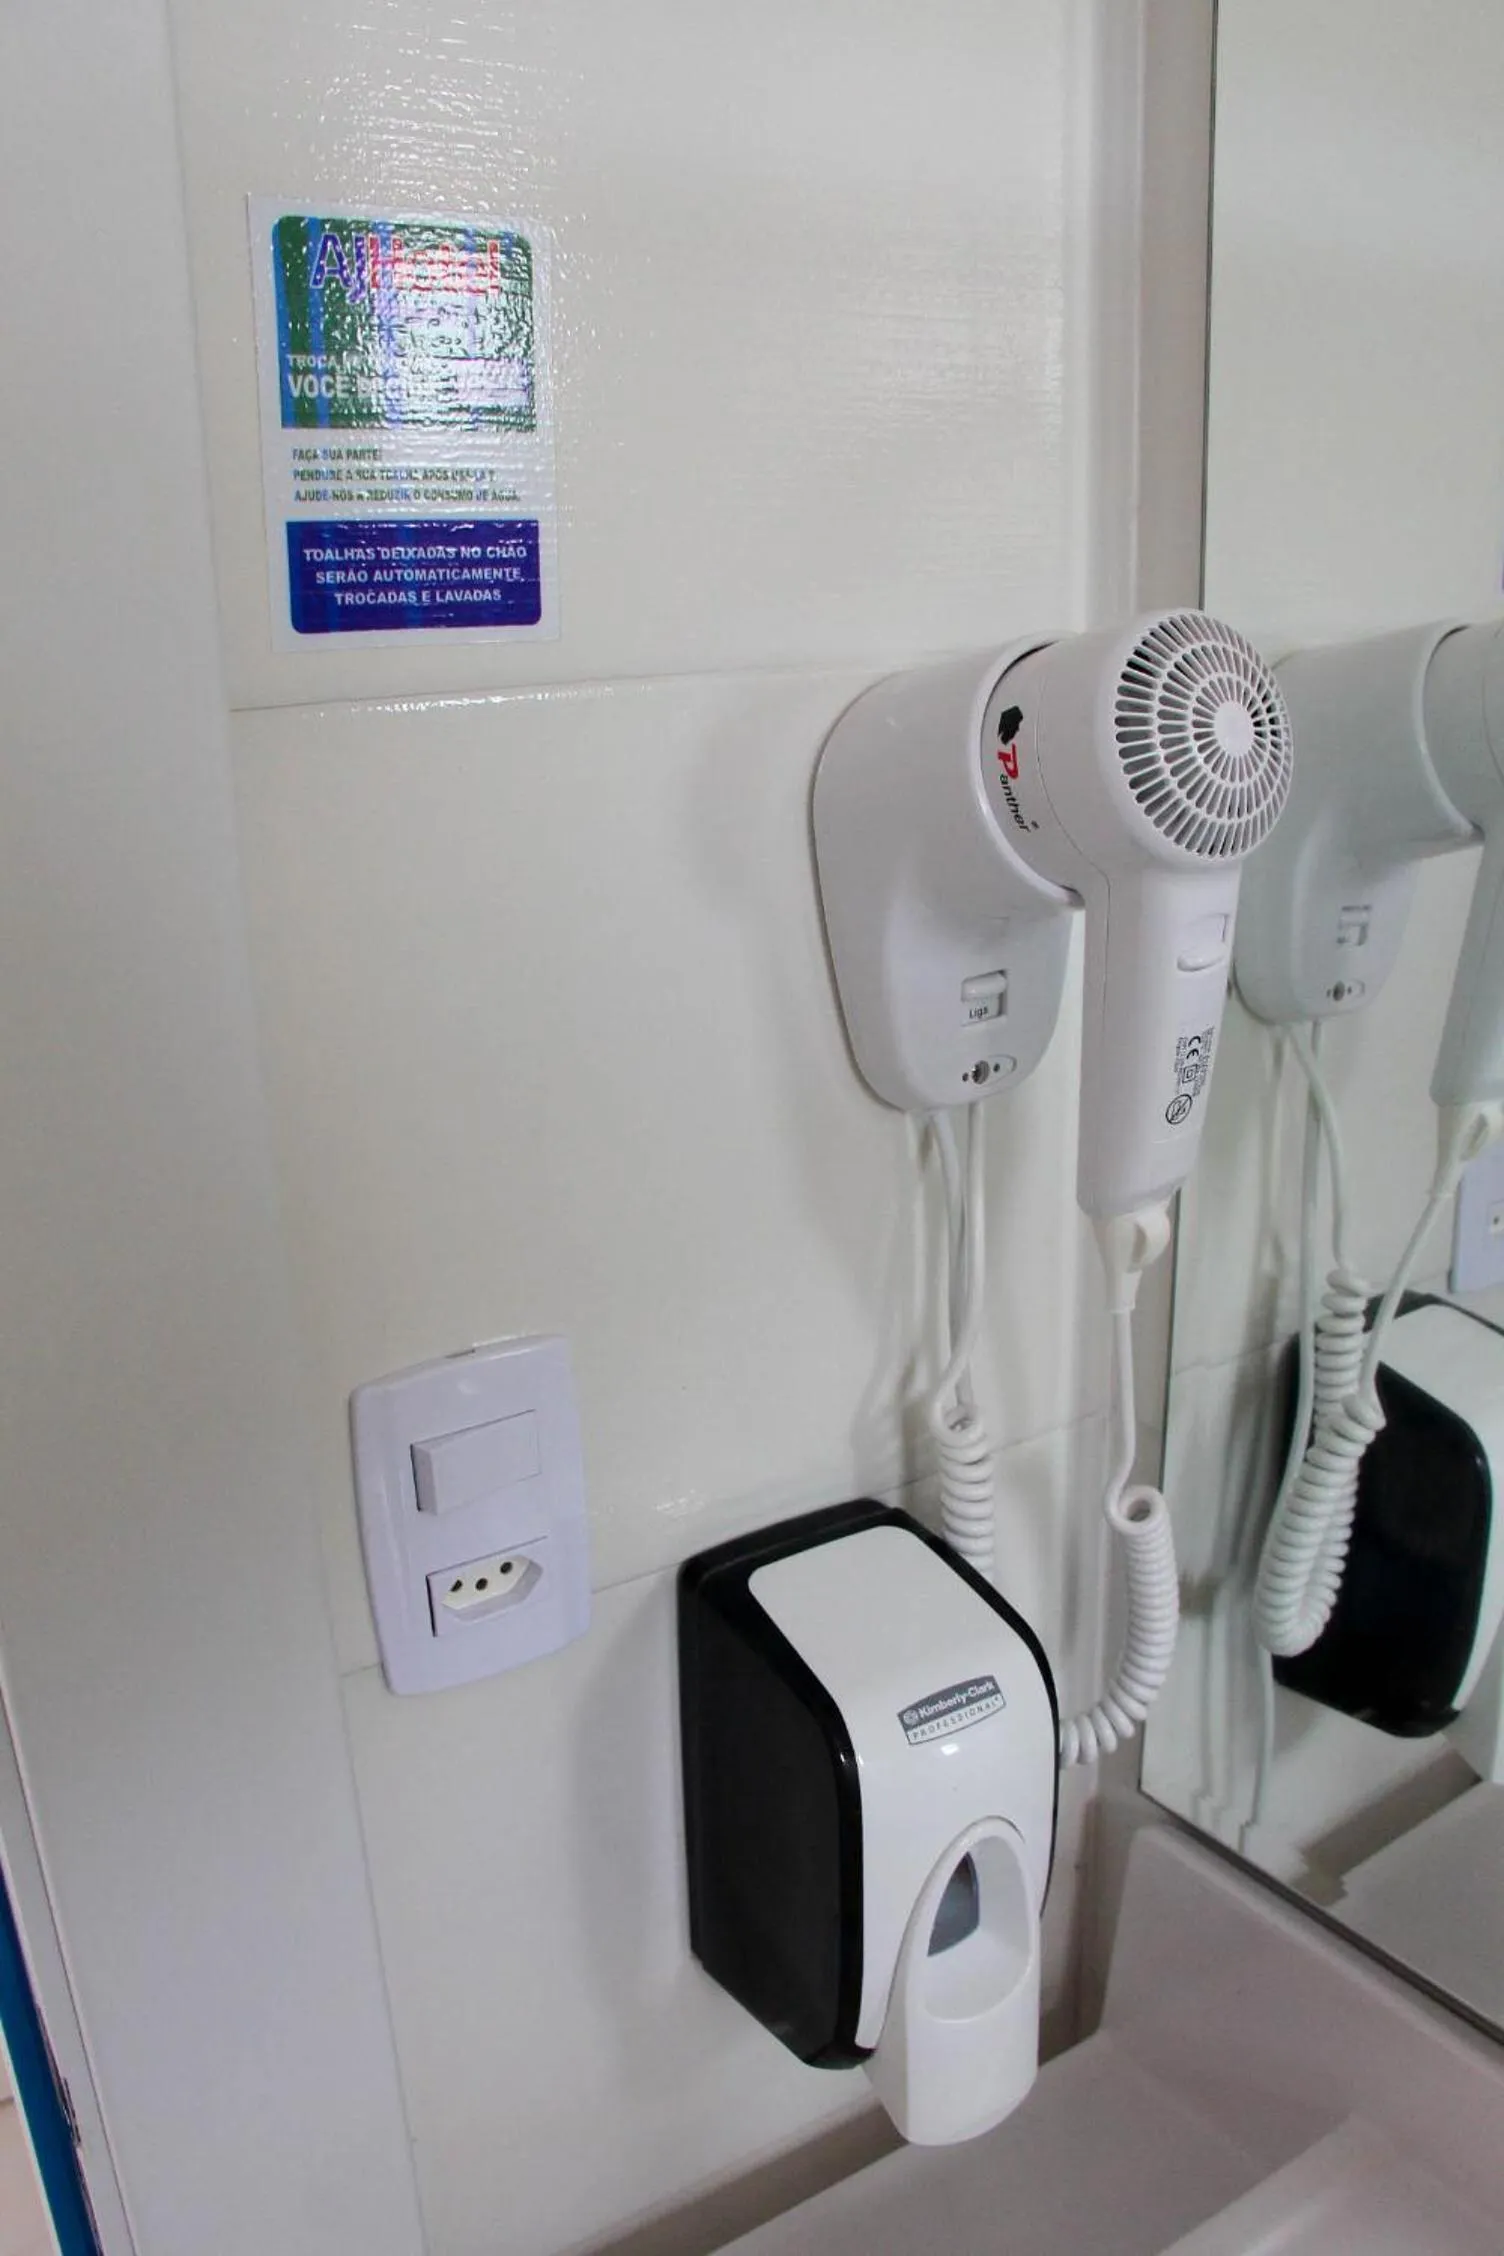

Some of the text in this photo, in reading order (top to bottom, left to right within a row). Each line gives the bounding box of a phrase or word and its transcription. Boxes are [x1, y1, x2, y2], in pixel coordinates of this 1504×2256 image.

[320, 448, 343, 461] SUA
[413, 488, 421, 501] O
[303, 547, 375, 561] TOALHAS
[380, 546, 458, 560] DEIXADAS
[461, 546, 481, 559] NO
[374, 567, 521, 582] AUTOMATICAMENTE
[334, 588, 501, 606] TROCADAS E LAVADAS
[997, 743, 1031, 833] Panther
